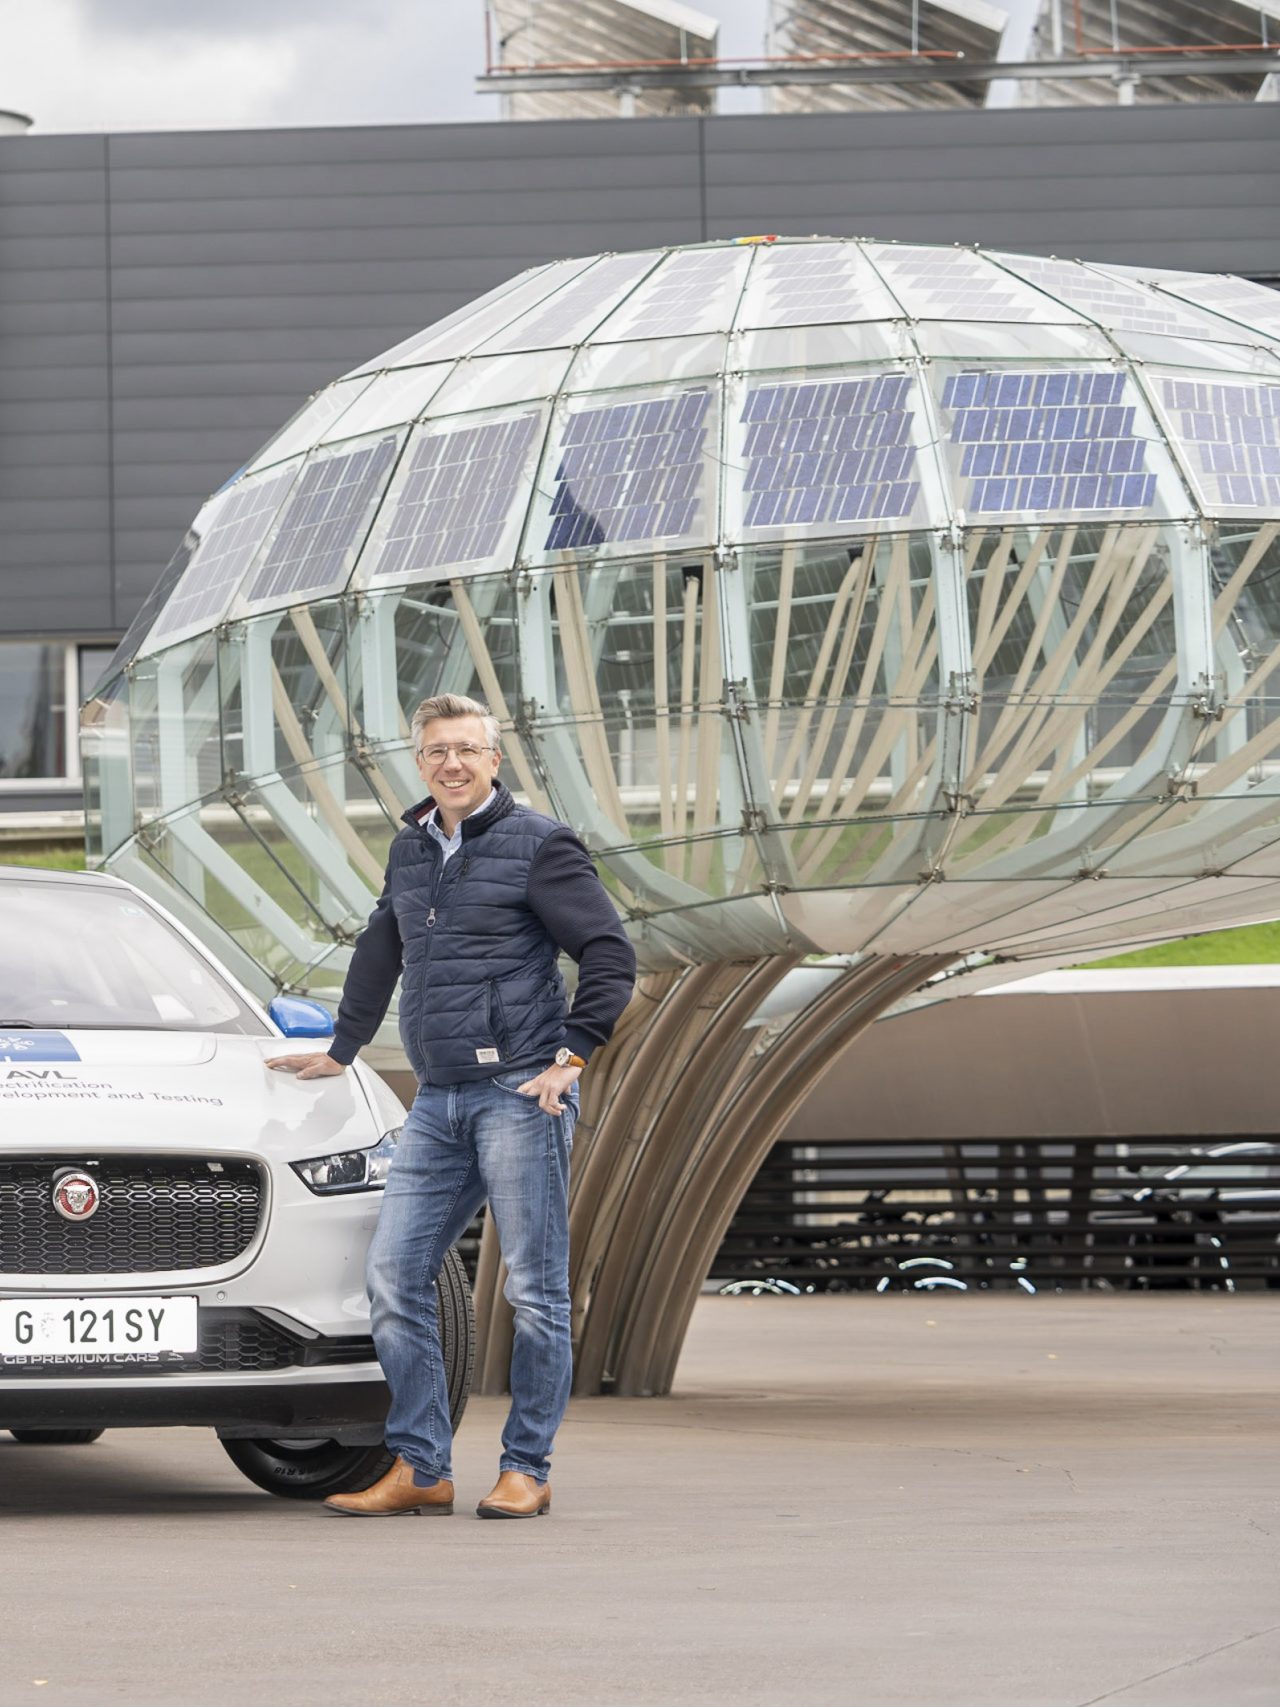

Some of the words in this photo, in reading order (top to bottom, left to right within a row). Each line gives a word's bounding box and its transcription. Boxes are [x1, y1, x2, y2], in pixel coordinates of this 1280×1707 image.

[6, 1070, 78, 1079] AVL
[107, 1091, 145, 1100] and
[148, 1092, 224, 1107] Testing
[15, 1310, 34, 1344] G
[3, 1354, 28, 1364] GB
[31, 1354, 112, 1364] PREMIUM
[113, 1352, 160, 1363] CARS
